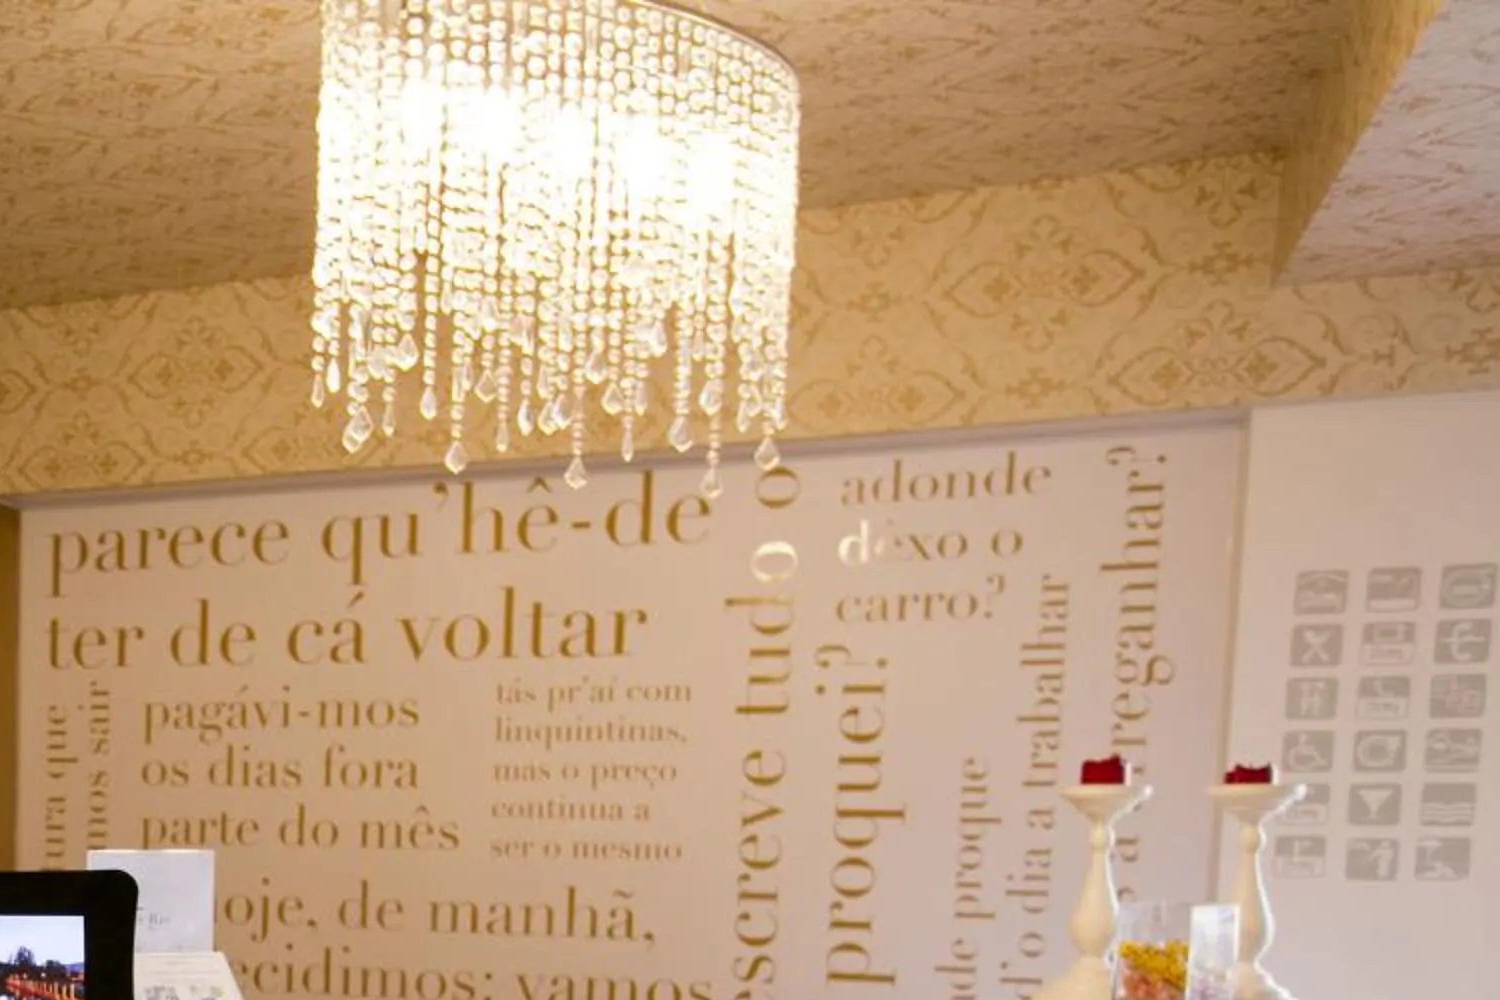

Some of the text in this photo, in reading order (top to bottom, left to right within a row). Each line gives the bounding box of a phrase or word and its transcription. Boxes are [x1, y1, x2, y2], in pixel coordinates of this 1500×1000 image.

[754, 465, 800, 511] o
[840, 451, 1052, 508] adonde
[47, 520, 291, 599] parece
[988, 529, 1025, 558] o
[46, 584, 651, 670] ter de cá voltar
[722, 540, 800, 717] tudo
[834, 573, 1007, 625] carro?
[626, 683, 692, 703] com
[1019, 574, 1072, 788] trabalhar
[46, 703, 80, 780] que
[77, 681, 111, 755] sair
[143, 684, 421, 746] pagávi-mos
[140, 743, 419, 791] os dias fora
[492, 763, 678, 790] mas o preço
[139, 802, 460, 851] parte do mês
[490, 796, 651, 822] continua a
[814, 643, 907, 988] proquei?
[955, 756, 1002, 921] proque
[1026, 807, 1057, 831] a
[489, 841, 683, 862] ser o mesmo
[1005, 847, 1054, 915] dia
[215, 877, 319, 943] oje,
[337, 878, 405, 931] de
[428, 885, 656, 944] manhã,
